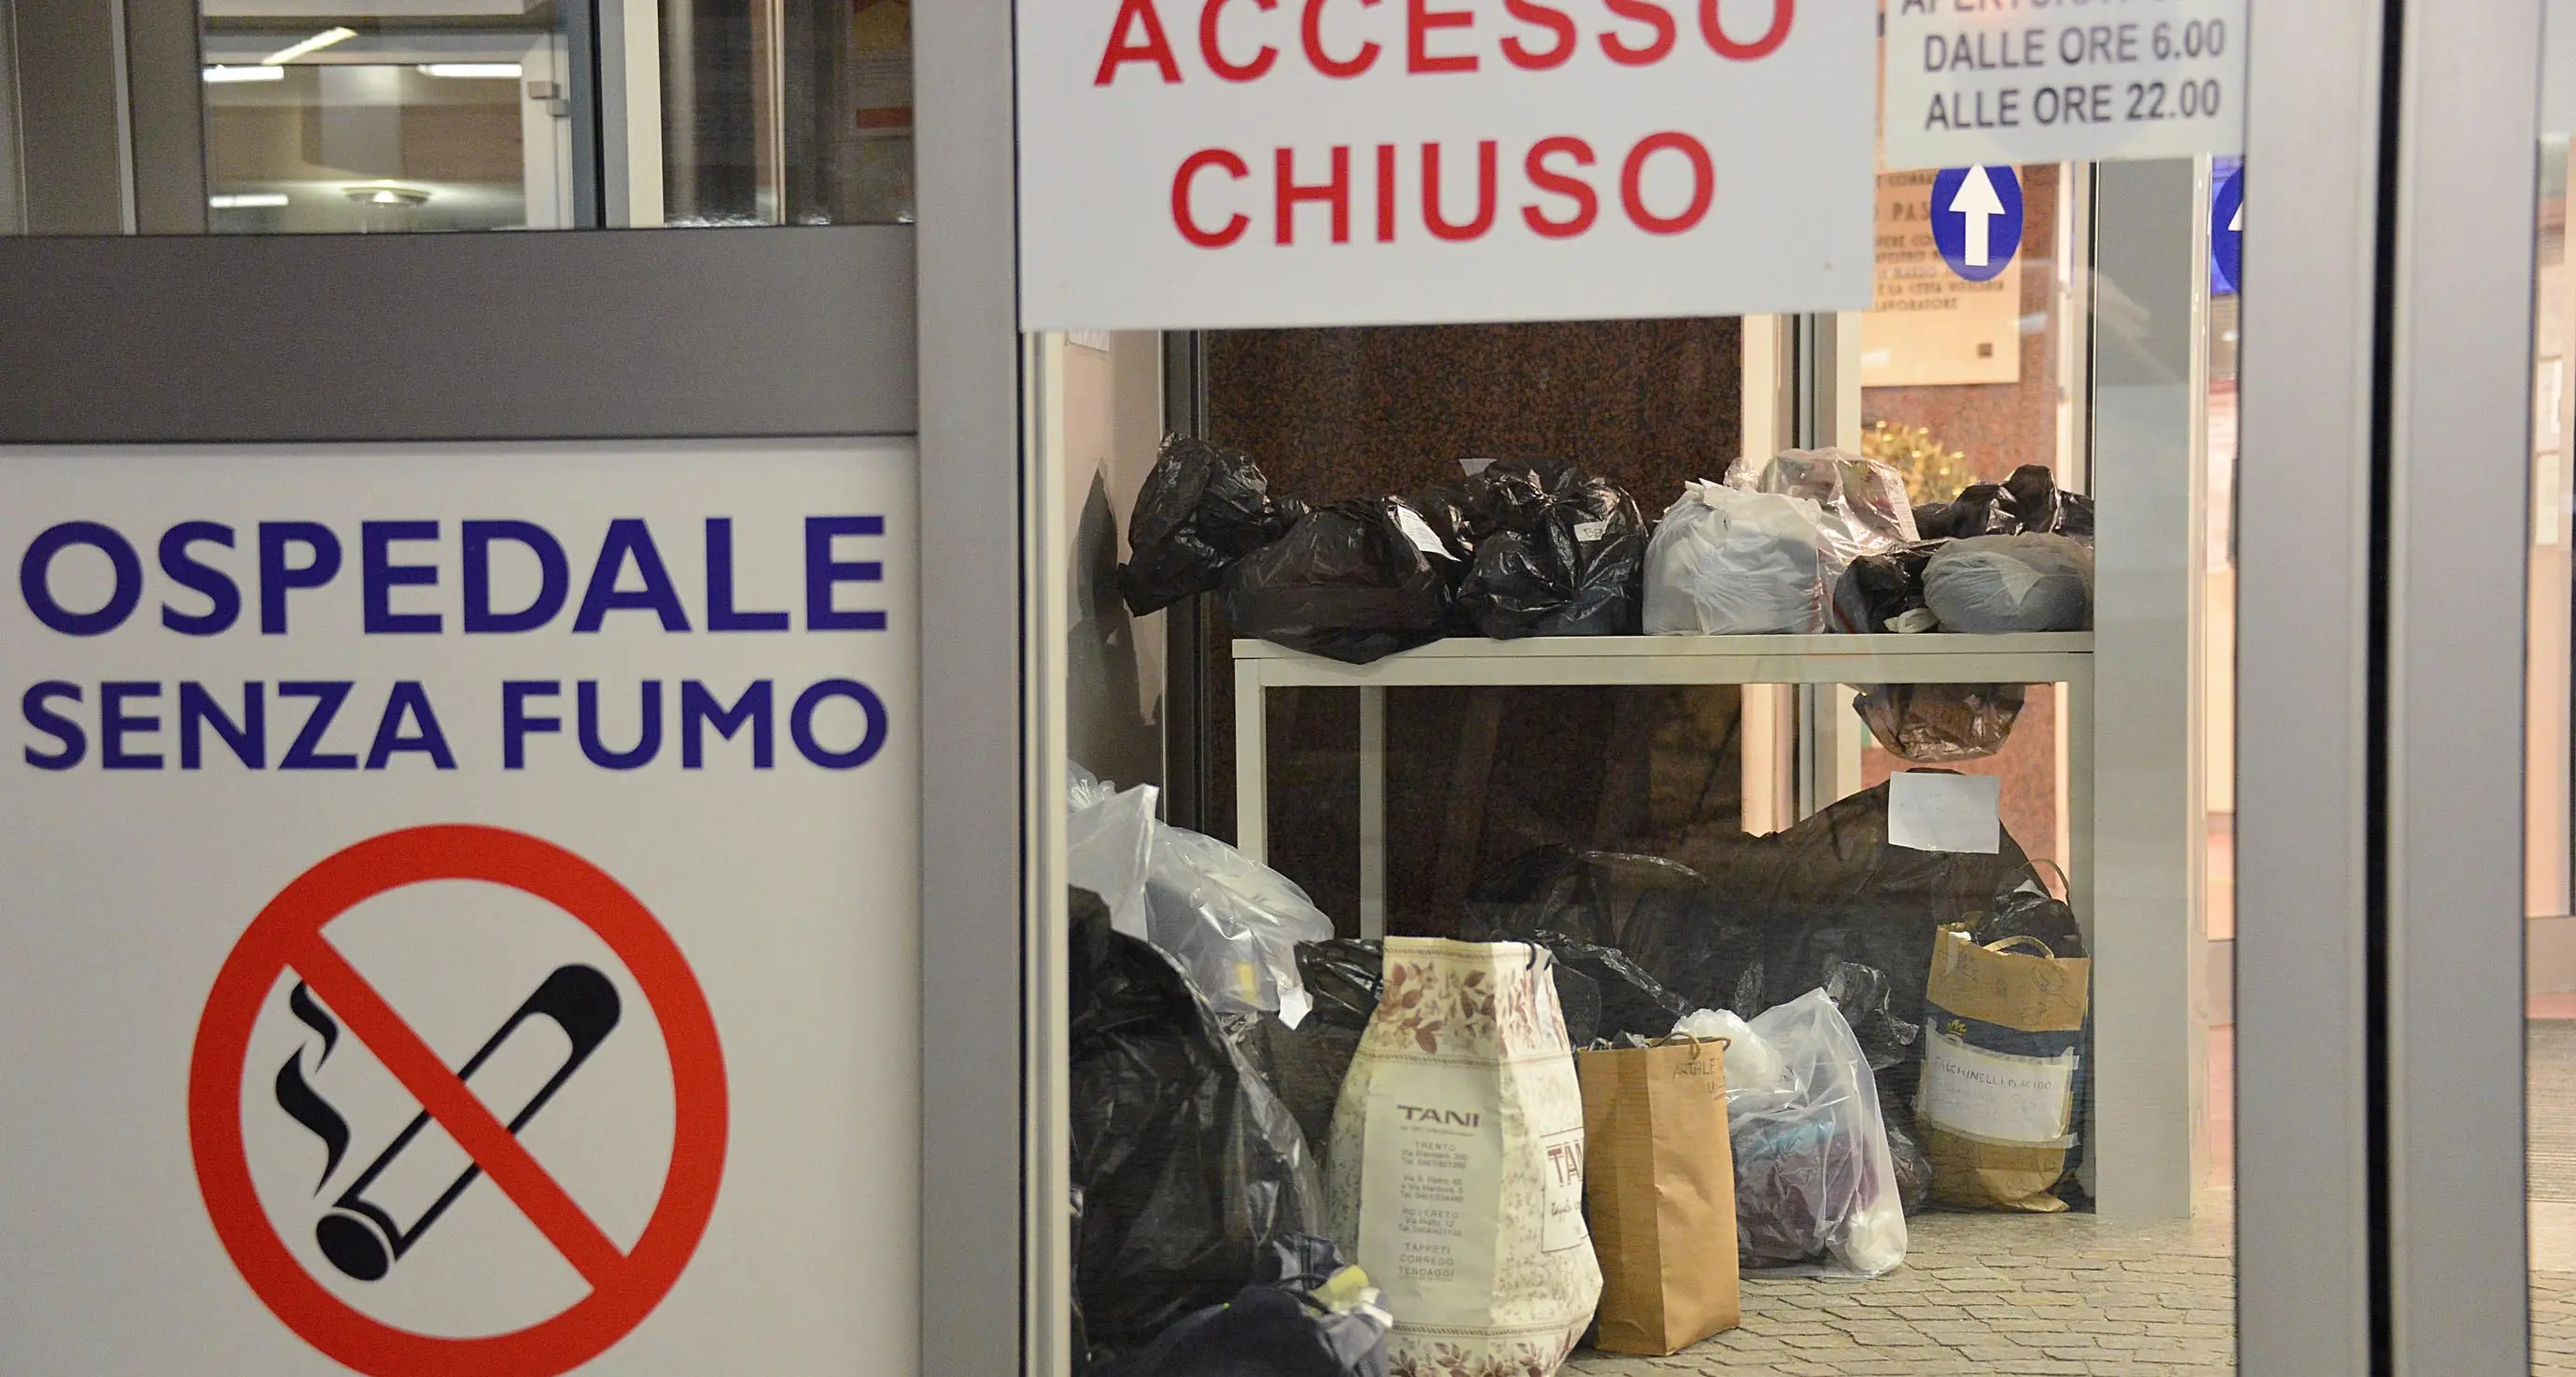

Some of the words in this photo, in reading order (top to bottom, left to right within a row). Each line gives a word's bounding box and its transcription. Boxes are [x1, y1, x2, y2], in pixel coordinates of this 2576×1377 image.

[1095, 0, 1793, 85] ACCESSO
[1925, 29, 2045, 73] DALLE
[2059, 24, 2138, 65] ORE
[2151, 19, 2224, 61] 6.00
[1925, 88, 2020, 130] ALLE
[2033, 83, 2113, 126] ORE
[2126, 78, 2220, 122] 22.00
[1171, 133, 1714, 247] CHIUSO
[21, 516, 886, 637] OSPEDALE
[23, 681, 456, 770] SENZA
[503, 679, 887, 770] FUMO
[1396, 1104, 1480, 1128] TANI
[1399, 1265, 1455, 1277] TENDAGGI
[1400, 1254, 1454, 1266] CORREDO
[1405, 1242, 1450, 1254] TAPPETI
